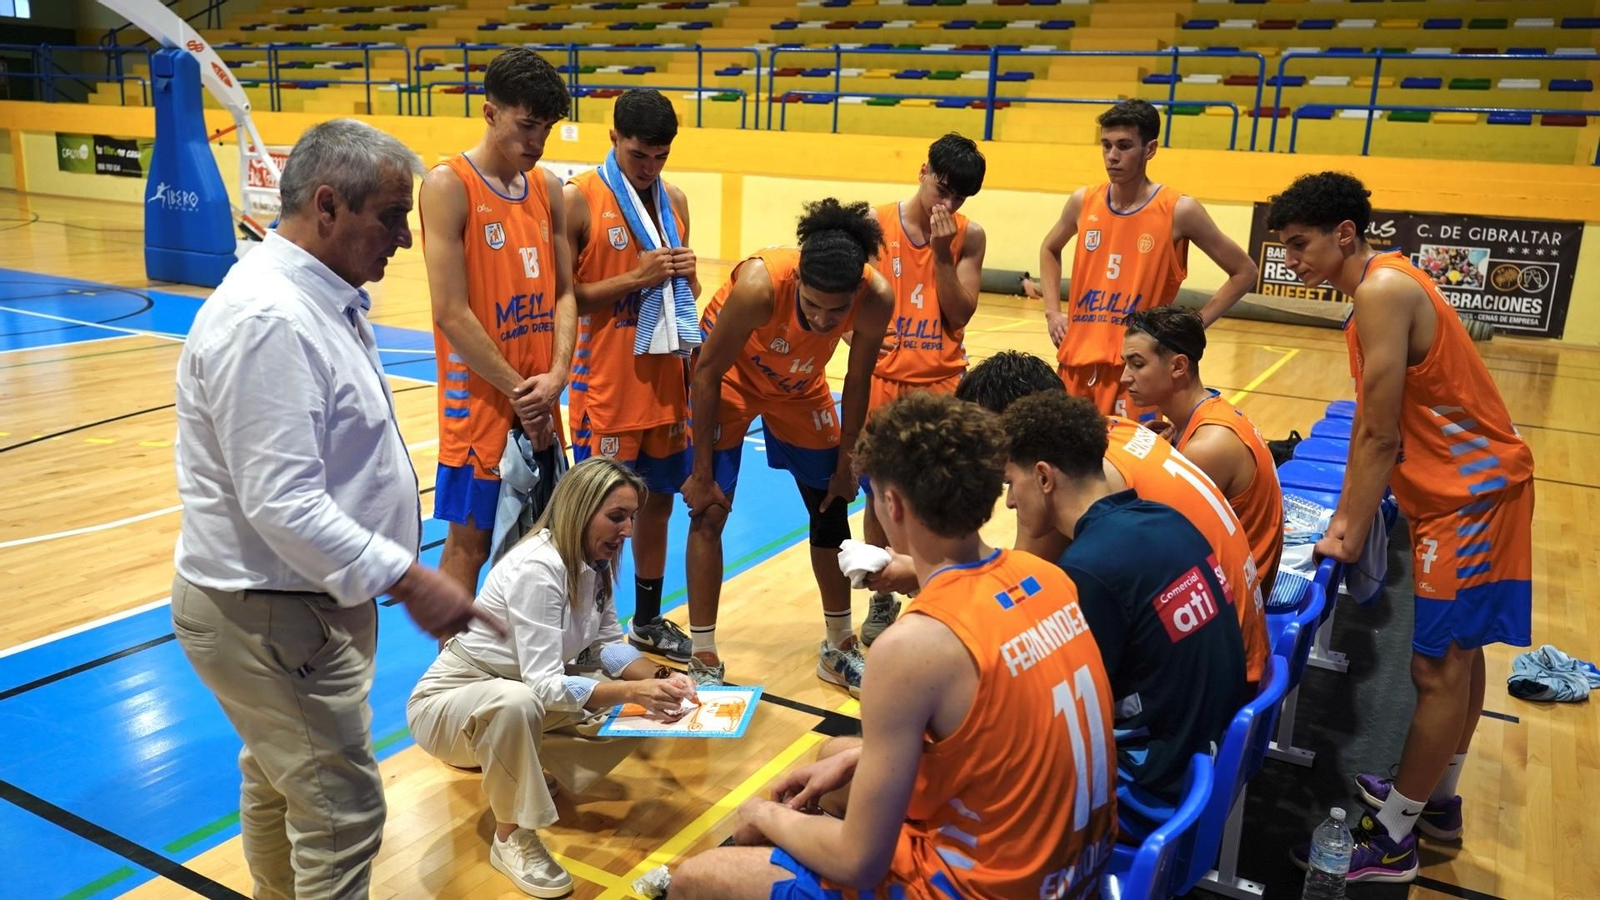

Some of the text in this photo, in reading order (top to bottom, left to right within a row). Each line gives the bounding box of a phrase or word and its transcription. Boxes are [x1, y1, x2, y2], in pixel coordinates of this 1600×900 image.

[166, 189, 199, 208] IBERO
[1416, 224, 1562, 246] C. DE GIBRALTAR
[518, 246, 541, 279] 13
[1106, 253, 1122, 280] 5
[910, 283, 924, 310] 4
[1477, 313, 1498, 322] CENAS
[1508, 317, 1540, 326] EMPRESA
[788, 355, 817, 374] 14
[812, 409, 835, 431] 14
[1162, 445, 1240, 537] 1
[1421, 538, 1438, 574] 7
[1159, 571, 1200, 604] Comercial
[1172, 582, 1215, 633] ati
[1051, 663, 1108, 832] 11
